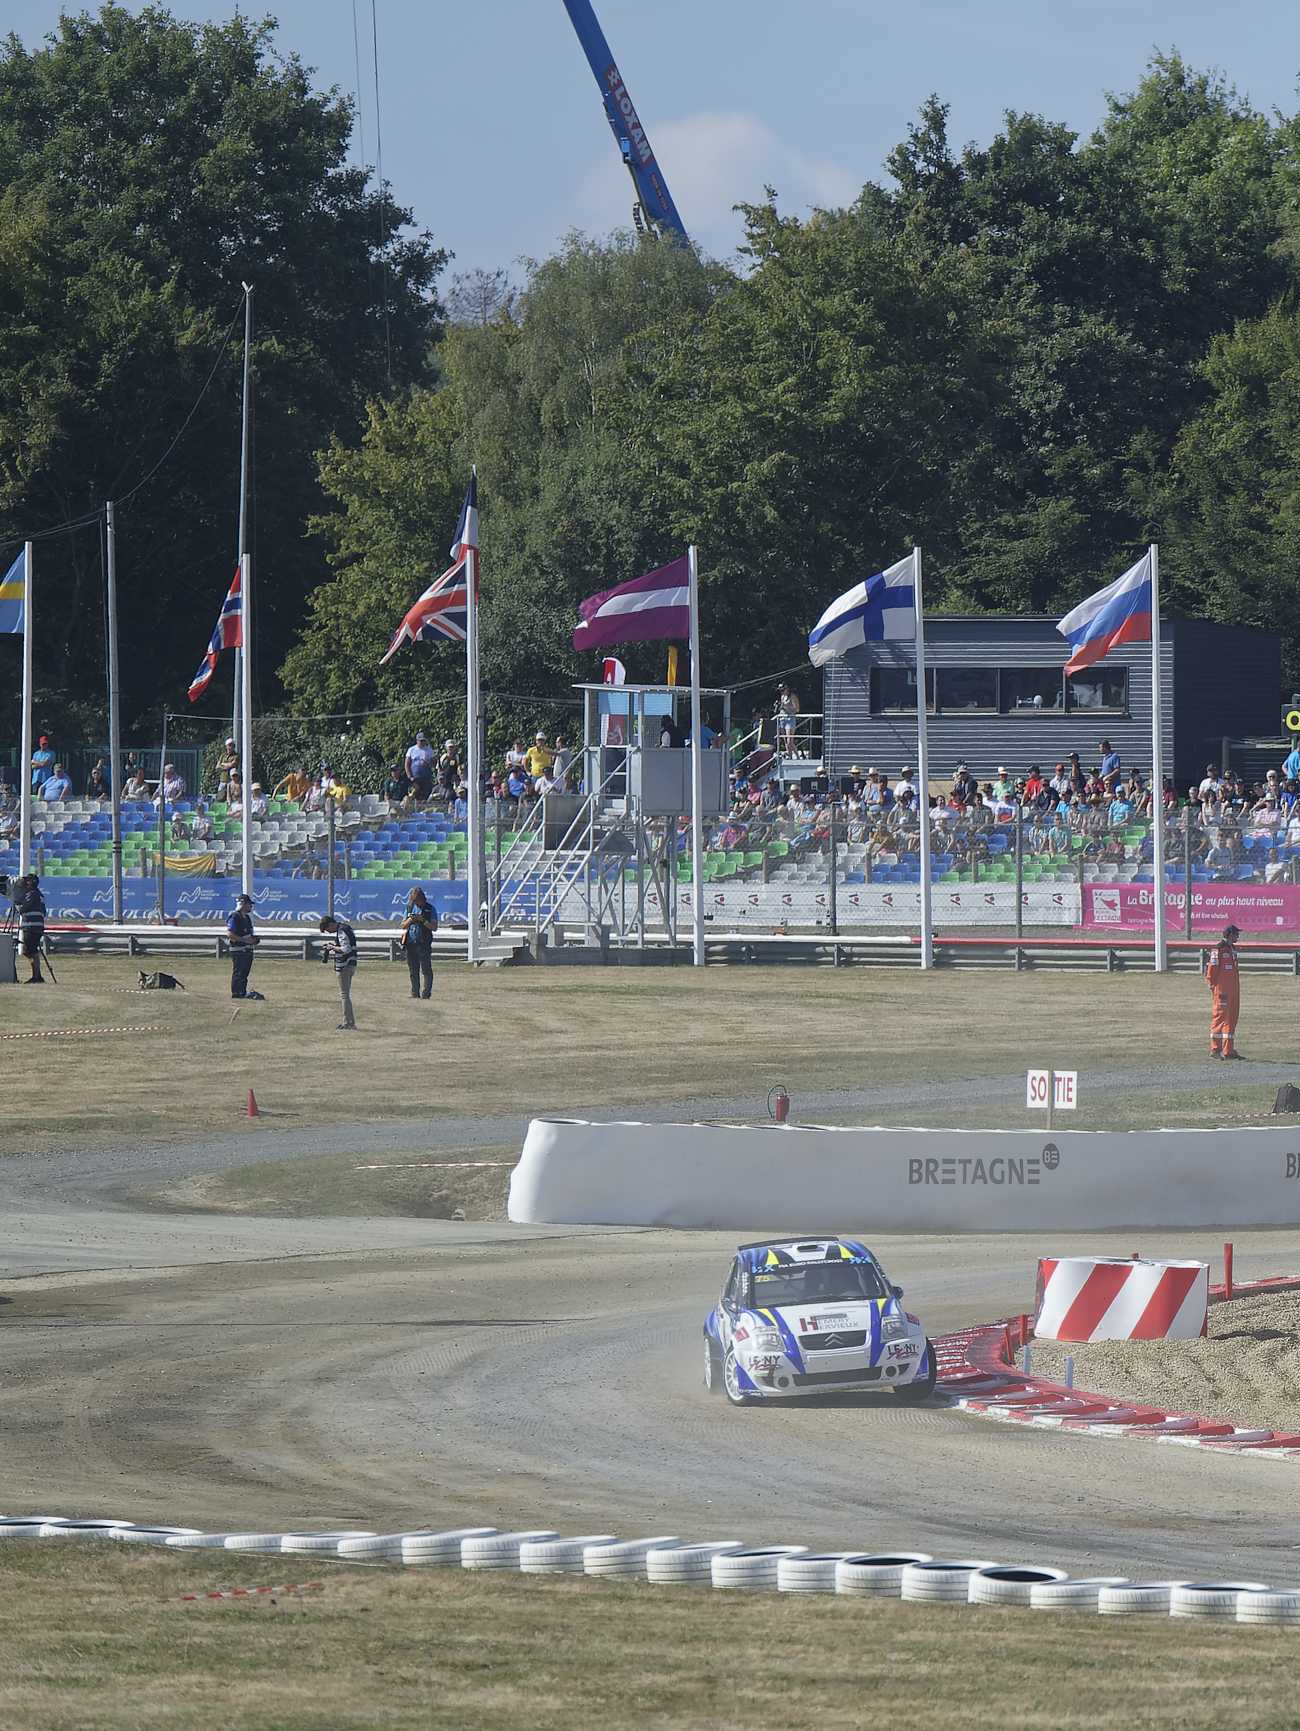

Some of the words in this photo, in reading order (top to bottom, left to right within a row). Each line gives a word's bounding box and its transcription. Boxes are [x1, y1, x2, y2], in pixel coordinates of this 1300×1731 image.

[1127, 895, 1137, 905] La
[1138, 890, 1203, 909] Brtage
[1217, 896, 1235, 907] plus
[1236, 896, 1255, 905] haut
[1257, 896, 1284, 906] niveau
[1031, 1076, 1072, 1102] SOTIE
[908, 1158, 1040, 1185] BRETAGNE
